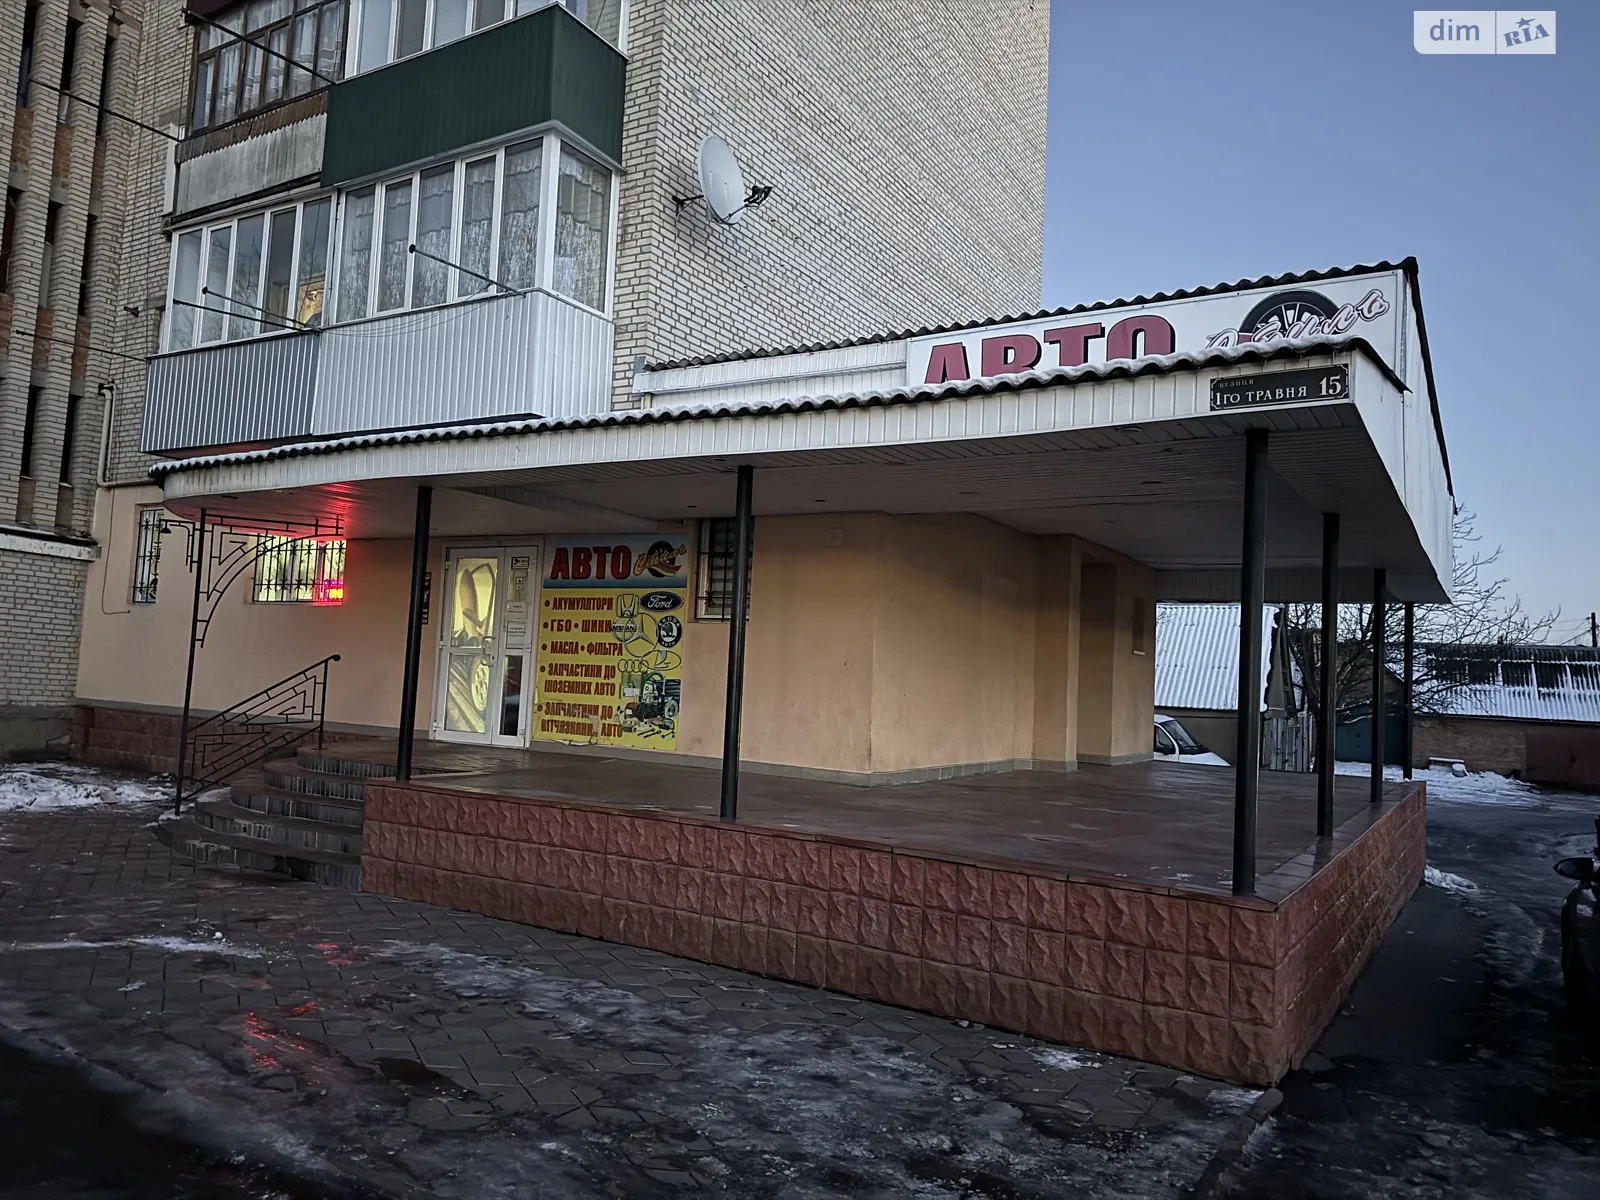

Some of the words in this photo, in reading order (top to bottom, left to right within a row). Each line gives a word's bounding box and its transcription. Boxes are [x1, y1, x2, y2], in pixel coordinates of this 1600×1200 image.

[1245, 386, 1307, 402] ТРАВНЯ
[1319, 374, 1342, 396] 15
[550, 545, 632, 579] АВТО
[552, 597, 613, 610] АКУМУЛЯТОРИ
[647, 594, 673, 609] Ford
[550, 619, 572, 632] ГБО
[581, 619, 612, 633] ШИНИ
[550, 641, 579, 655] МАСЛА
[586, 642, 623, 656] ФІЛЬТРА
[548, 663, 602, 679] ЗАПЧАСТИНИ
[603, 665, 616, 680] ДО
[544, 679, 592, 695] ІНОЗЕМНИХ
[593, 682, 616, 696] АВТО
[601, 705, 613, 720] ДО
[540, 719, 598, 737] ВІТЧИЗНЯНИ
[601, 722, 623, 738] АВТО
